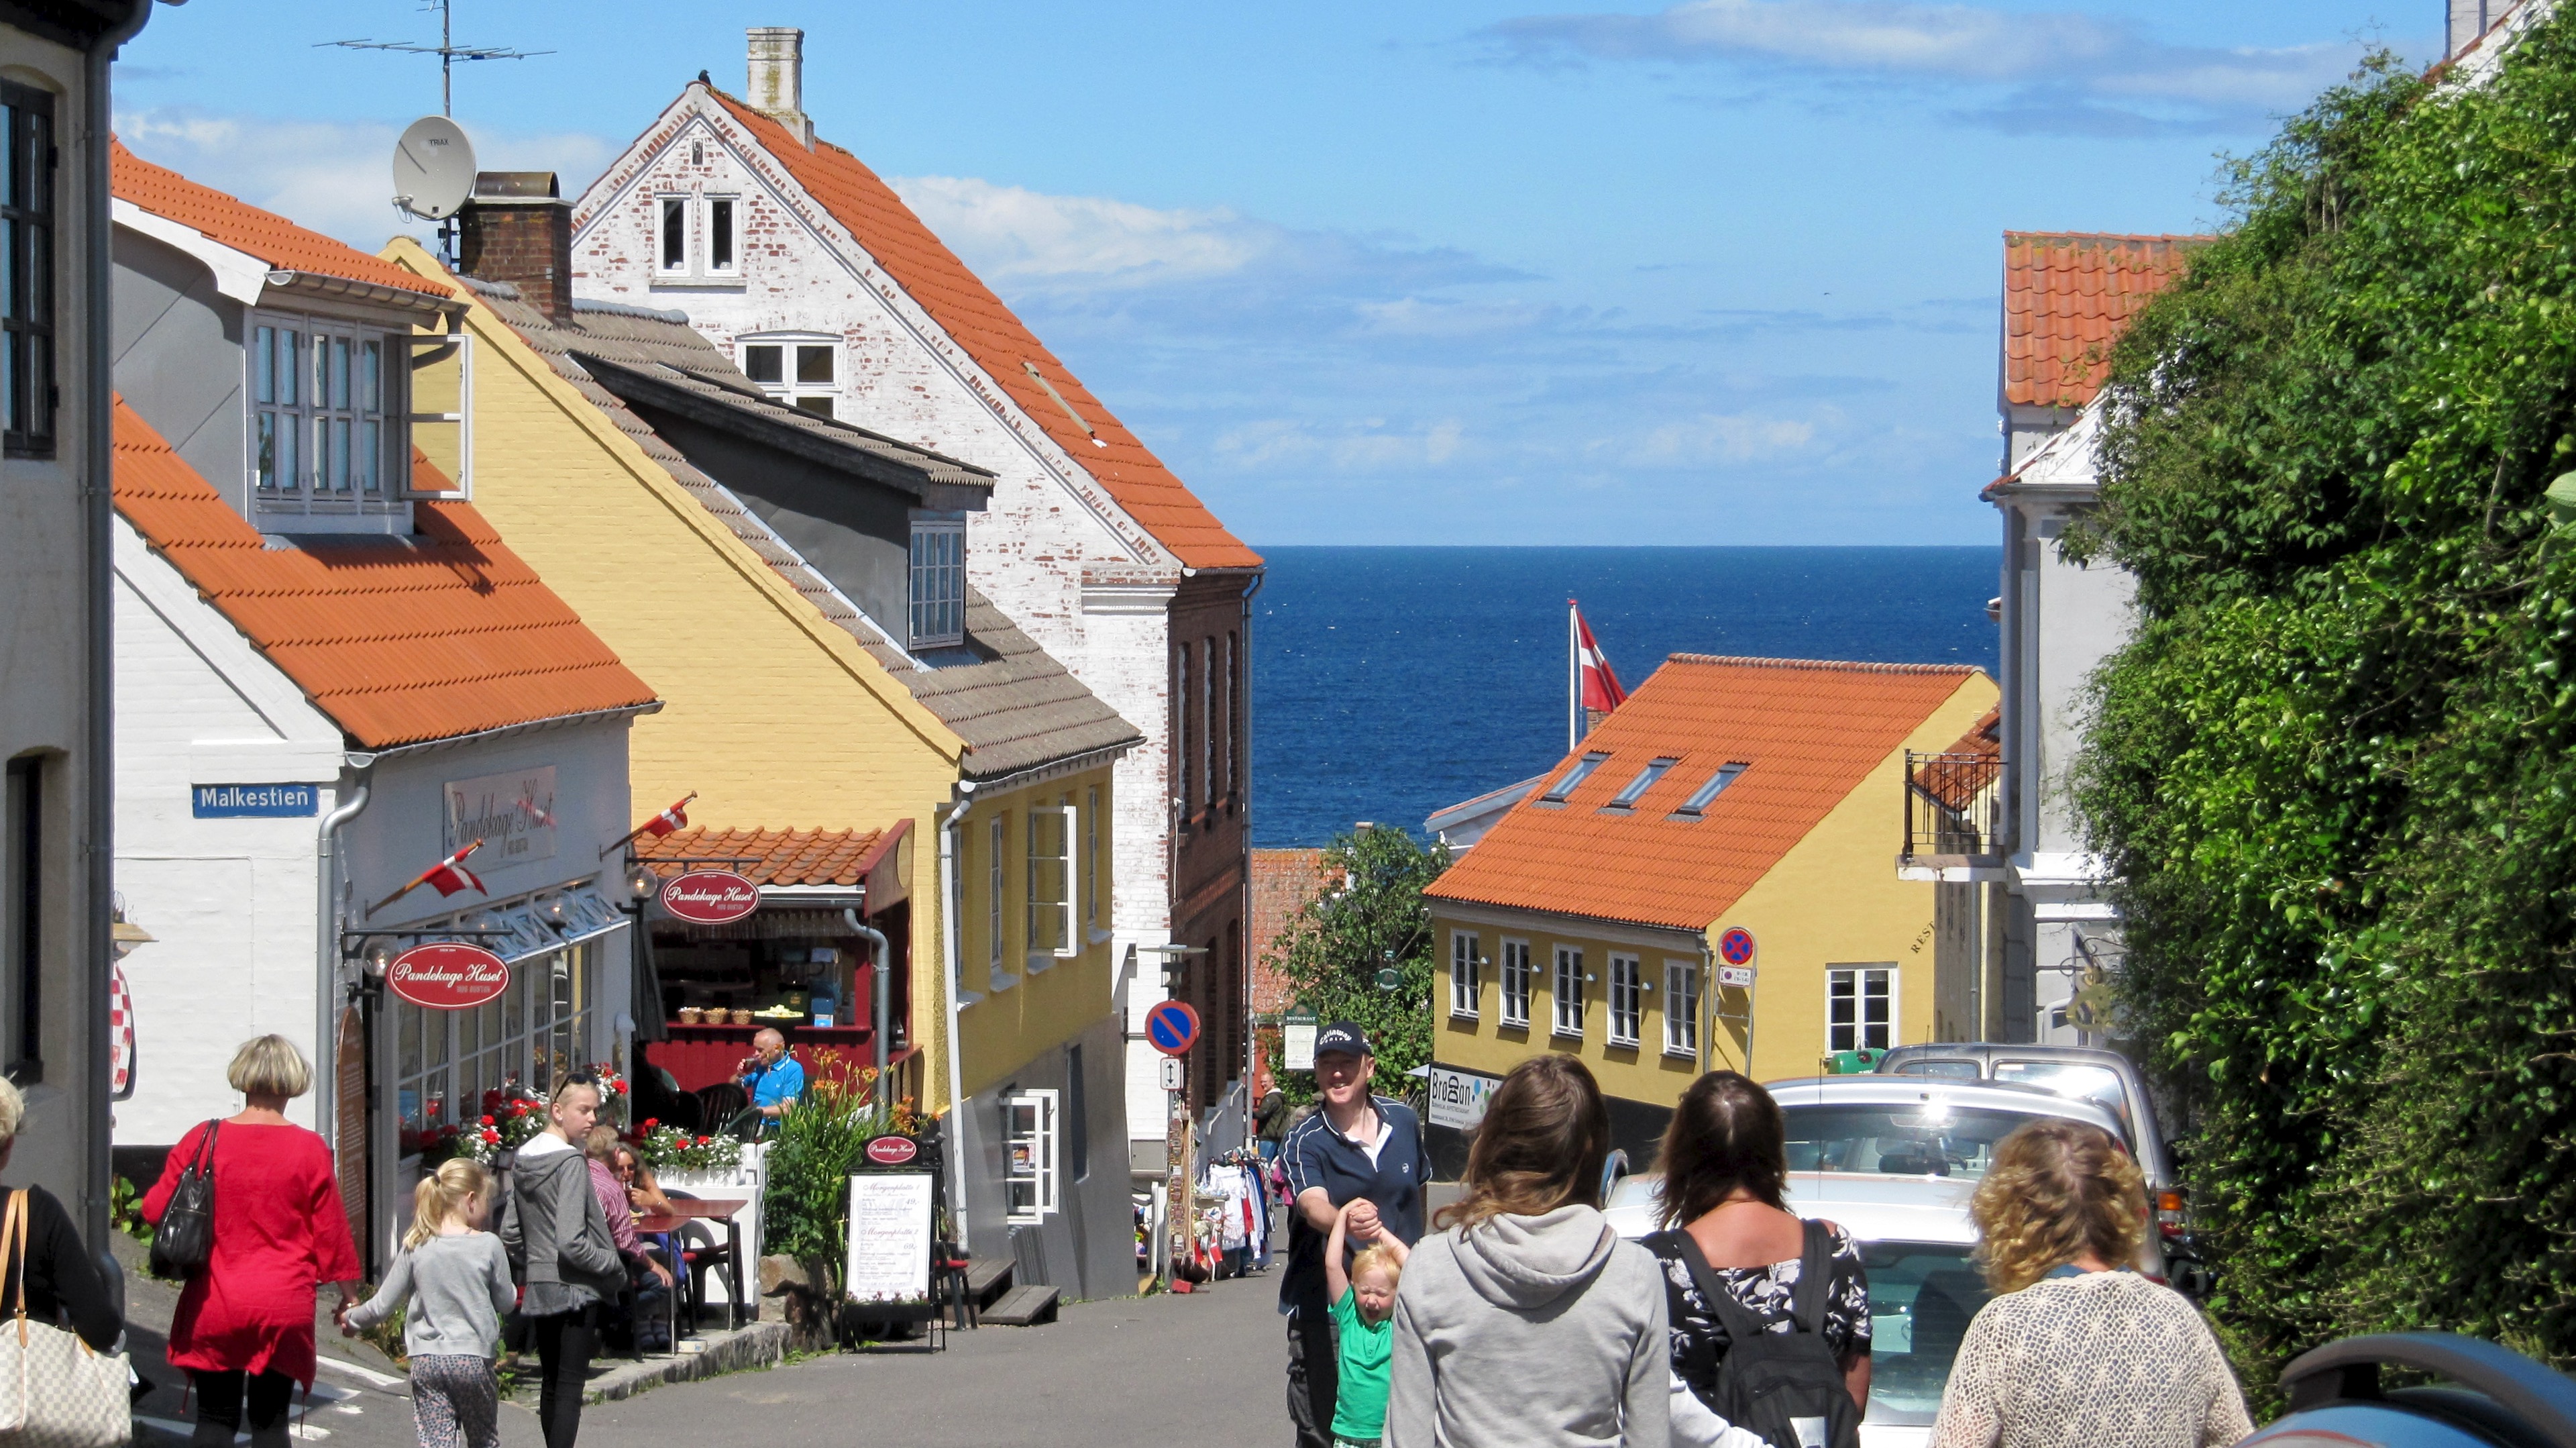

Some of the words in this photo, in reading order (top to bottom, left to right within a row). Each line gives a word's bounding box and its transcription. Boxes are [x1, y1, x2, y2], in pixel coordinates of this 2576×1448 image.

[429, 138, 449, 146] TRIAX
[201, 786, 309, 807] Malkestien
[667, 886, 722, 907] Pandekage
[723, 886, 754, 902] Huset
[394, 962, 464, 989] Pandekage
[464, 964, 504, 982] Huset
[1319, 1029, 1352, 1045] Callaway
